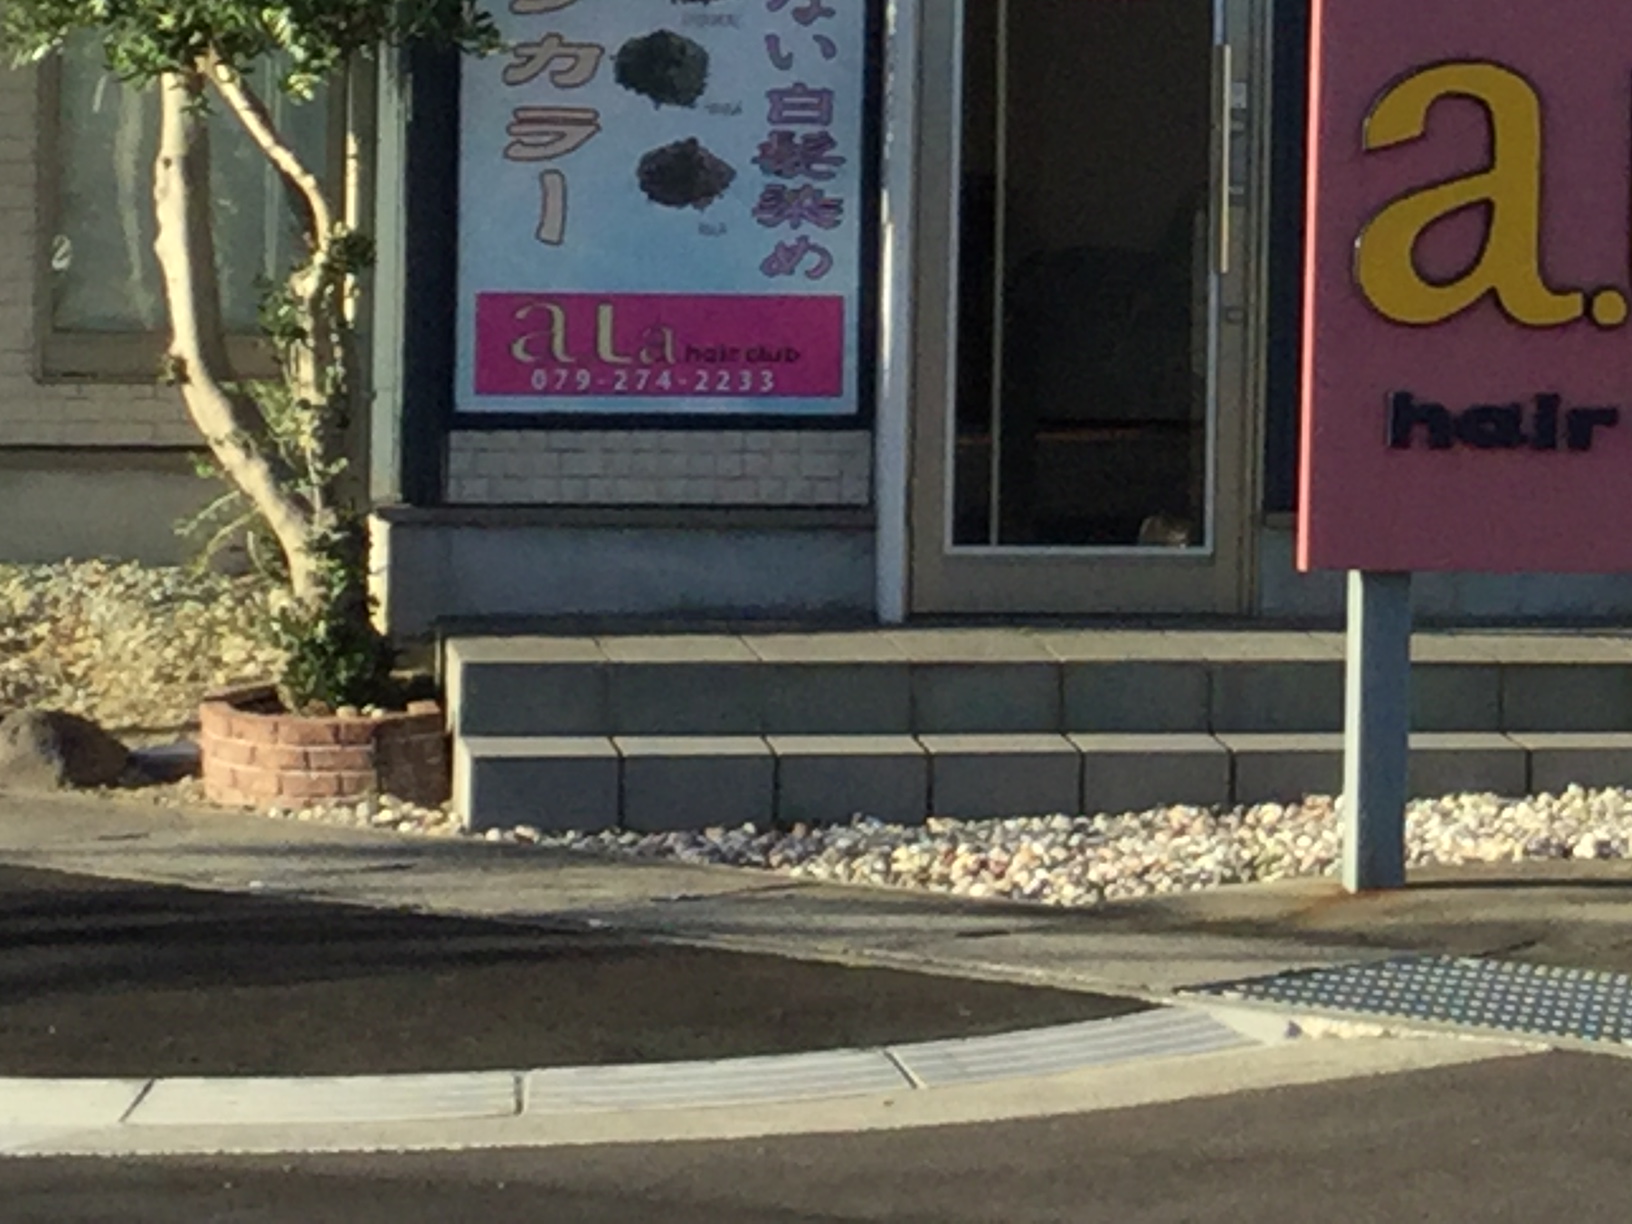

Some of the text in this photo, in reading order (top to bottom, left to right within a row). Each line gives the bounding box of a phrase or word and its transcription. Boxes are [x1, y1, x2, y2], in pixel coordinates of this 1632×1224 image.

[684, 344, 738, 363] hair
[746, 345, 801, 363] club
[530, 368, 776, 392] 079-274-2233
[1387, 391, 1618, 451] hair
